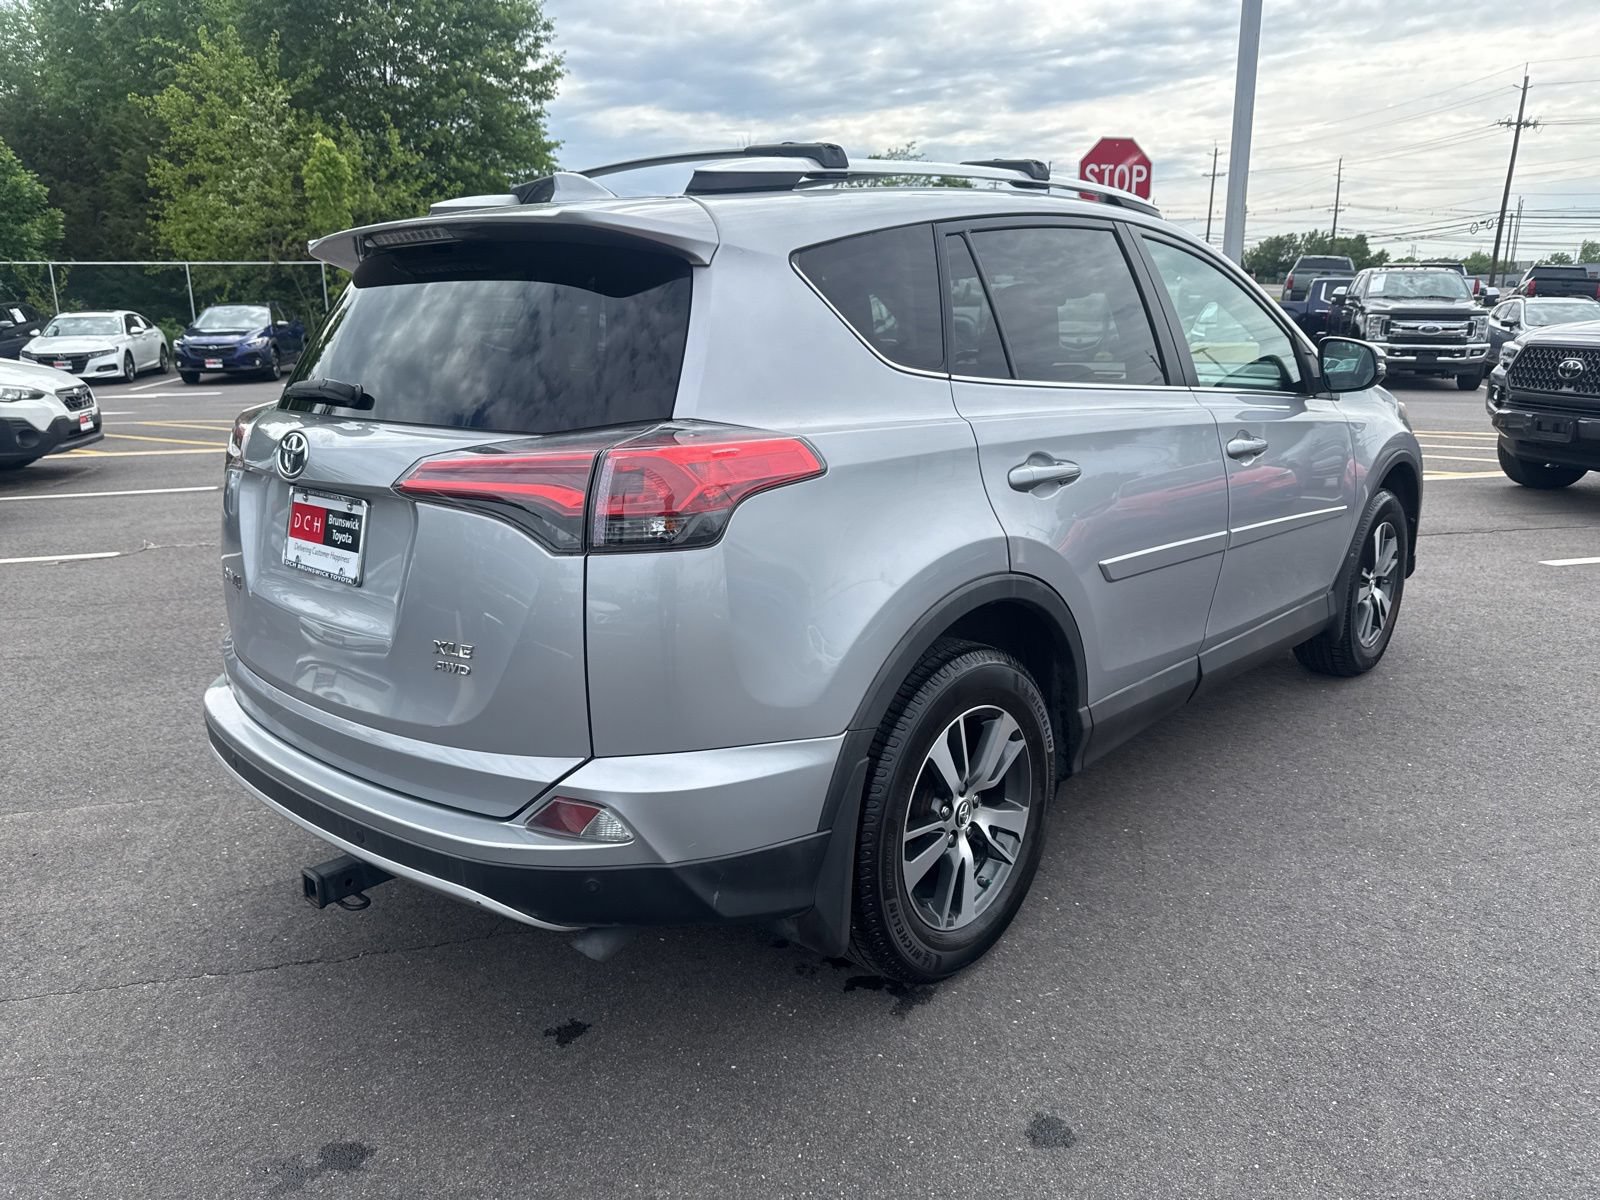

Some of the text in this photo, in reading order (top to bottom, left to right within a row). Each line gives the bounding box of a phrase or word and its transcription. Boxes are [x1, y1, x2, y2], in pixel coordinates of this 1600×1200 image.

[1085, 163, 1148, 194] STOP
[294, 512, 321, 533] DCH
[328, 514, 360, 530] Brunswick
[332, 529, 352, 544] Toyota
[285, 560, 353, 584] DCH BRUNSWICK TOYOTA
[433, 639, 473, 659] XLE
[436, 660, 471, 675] AWD
[1029, 691, 1053, 750] MICHELIN
[887, 901, 922, 960] MICHELIN
